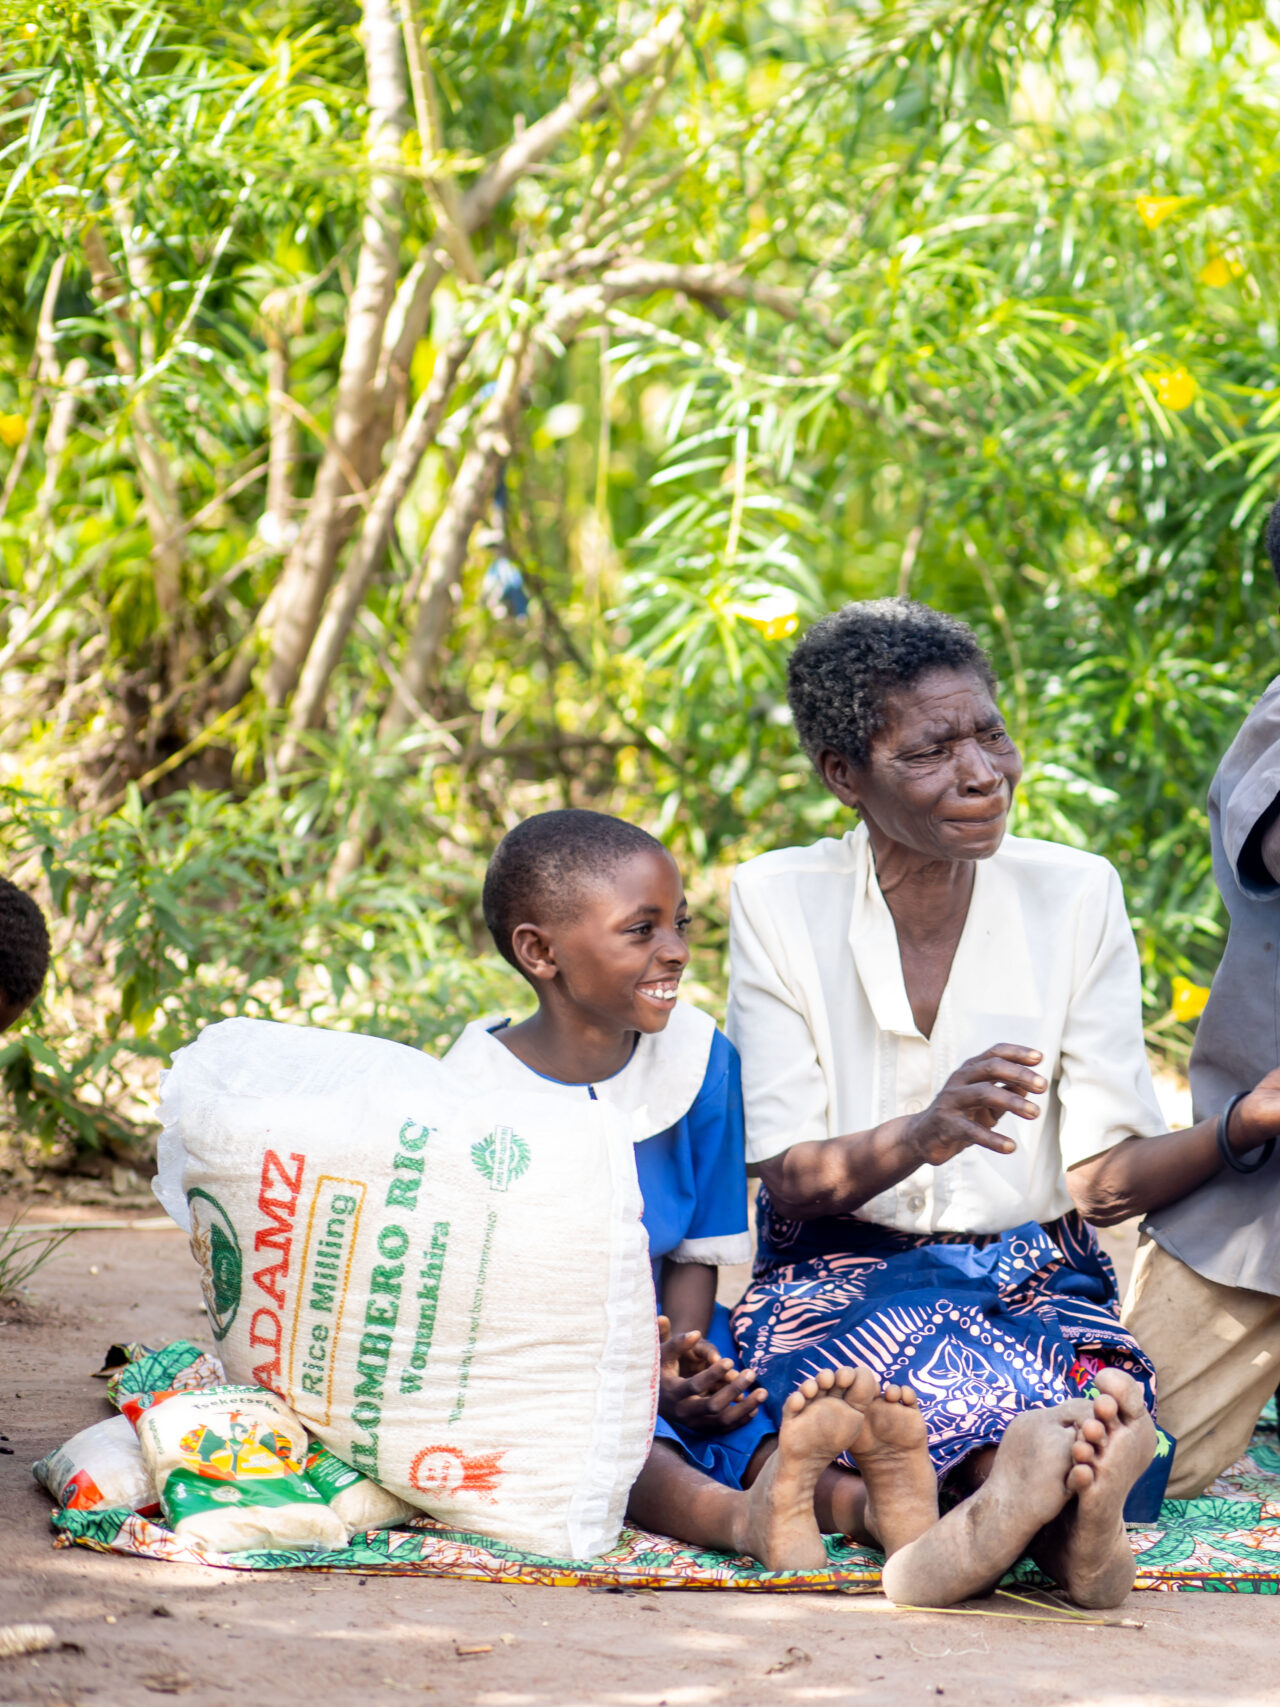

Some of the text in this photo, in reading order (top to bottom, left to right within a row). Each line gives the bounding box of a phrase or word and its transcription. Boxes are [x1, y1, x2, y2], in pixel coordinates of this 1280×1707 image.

[249, 1149, 306, 1397] ADAMZ
[301, 1193, 358, 1397] Rice Milling
[397, 1221, 452, 1394] Wonunkhira
[466, 1289, 486, 1315] been
